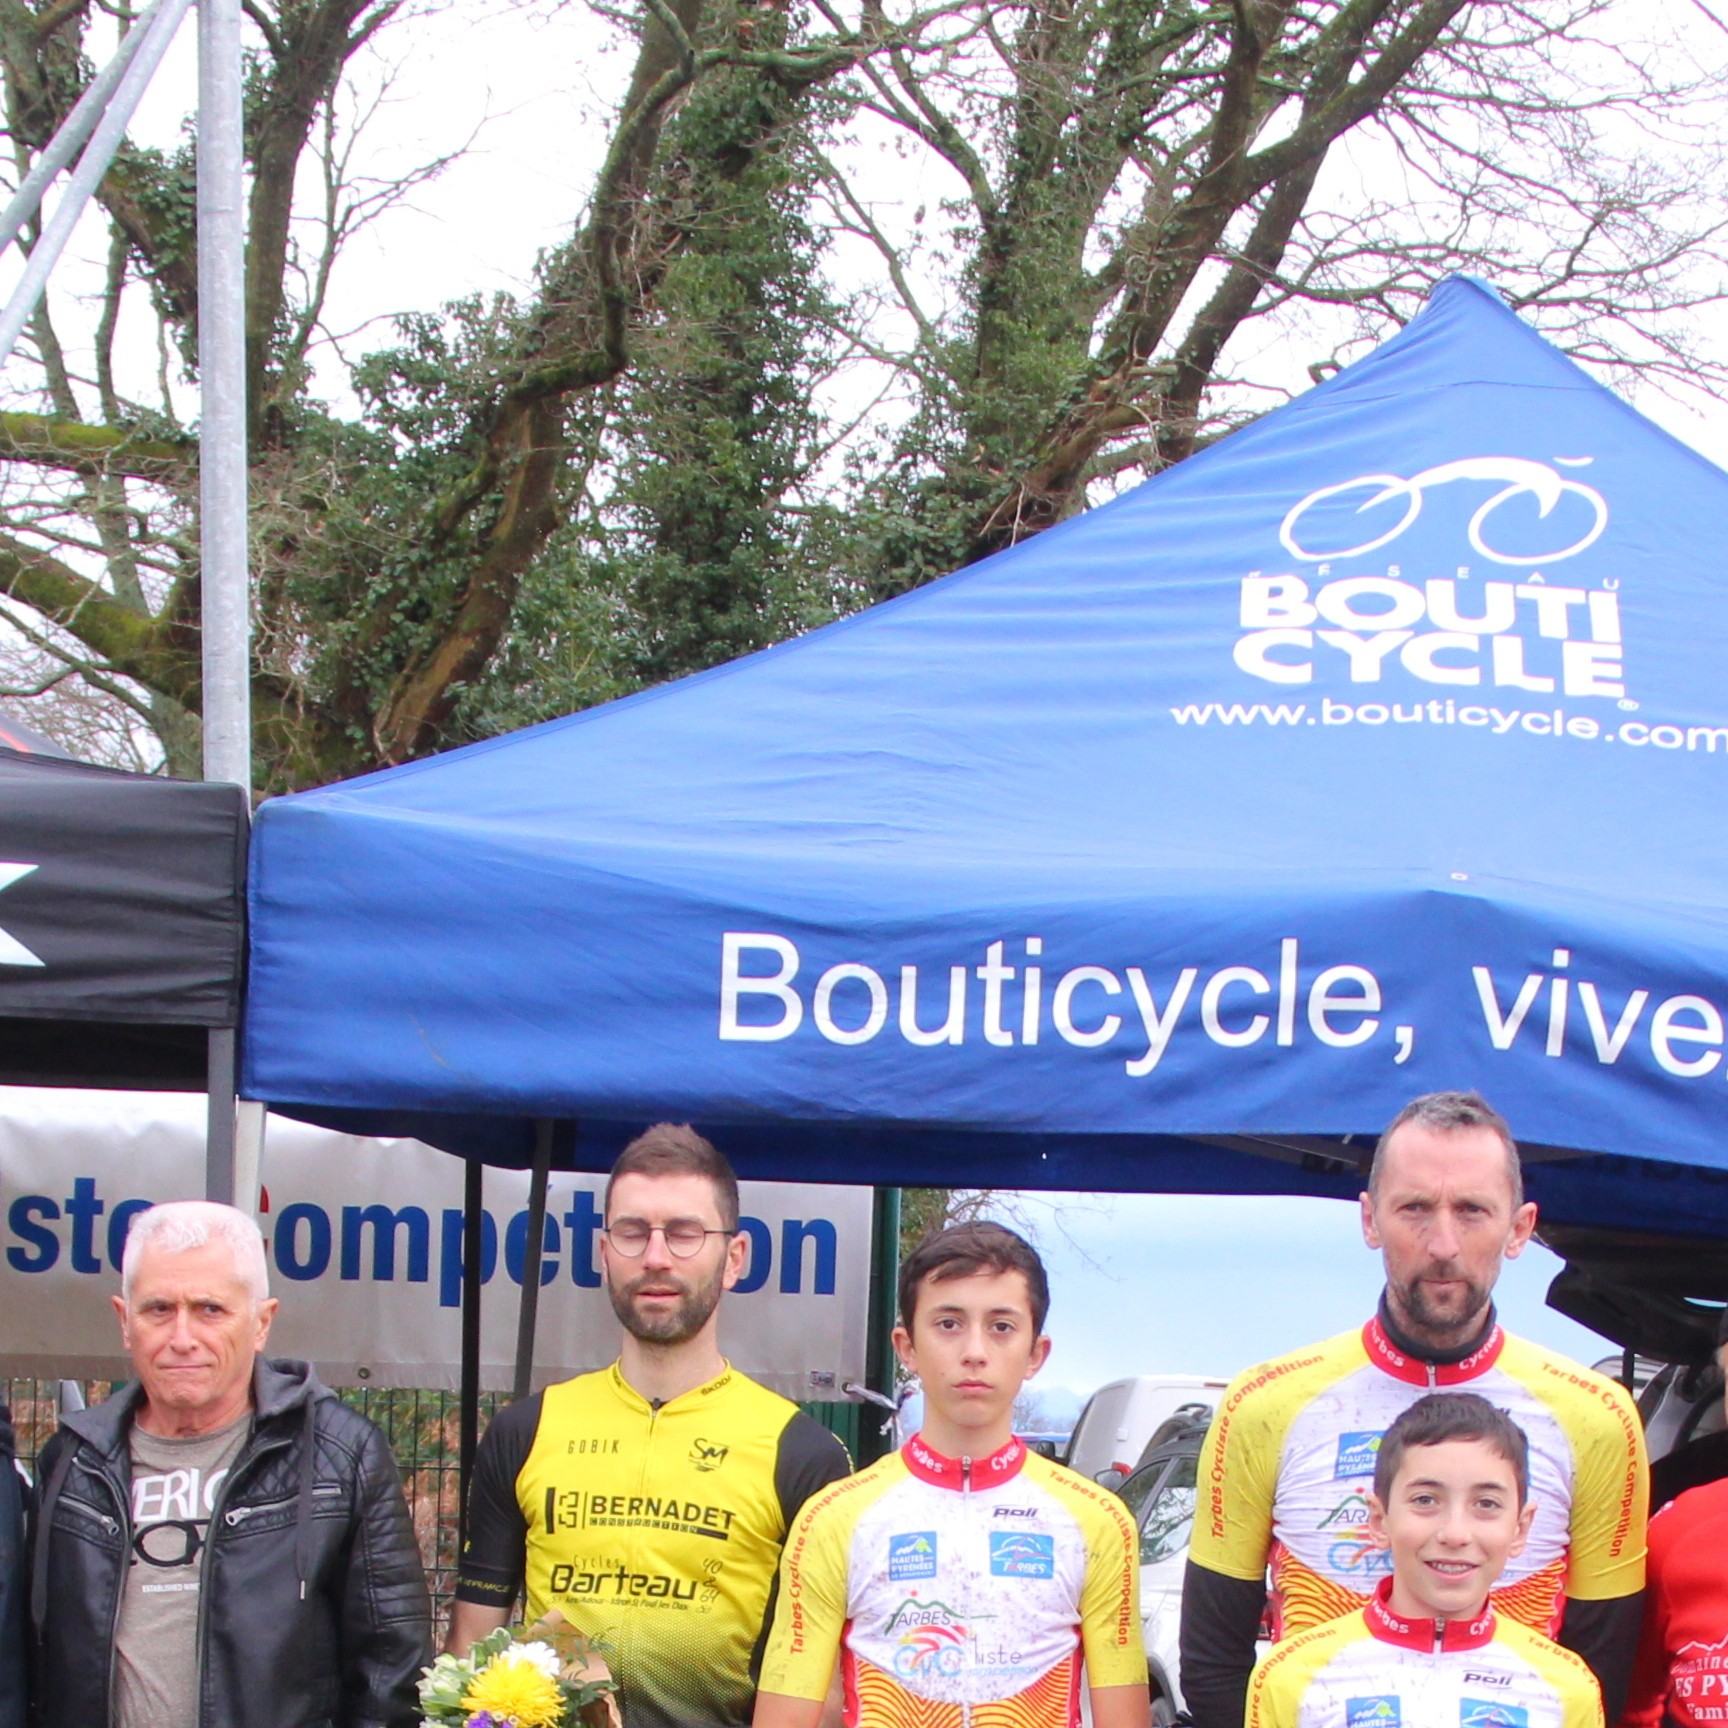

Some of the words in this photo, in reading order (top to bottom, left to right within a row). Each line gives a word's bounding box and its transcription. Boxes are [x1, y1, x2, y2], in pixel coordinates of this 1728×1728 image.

[1240, 575, 1621, 643] BOUTI
[1233, 628, 1626, 697] CYCLE
[719, 932, 1414, 1077] Bouticycle,
[1226, 1355, 1324, 1413] Competition
[1541, 1362, 1599, 1395] Tarbes
[568, 1440, 619, 1454] GOBIK
[1211, 1416, 1230, 1482] Cycliste
[1601, 1391, 1636, 1458] Cycliste
[590, 1495, 736, 1530] BERNADET
[800, 1473, 879, 1534] Competition
[993, 1506, 1039, 1518] poli
[1211, 1484, 1224, 1538] Tarbes
[1609, 1461, 1637, 1557] Competition
[551, 1564, 697, 1600] Barteau
[574, 1555, 619, 1571] Cycles
[789, 1536, 806, 1598] Cycliste
[1050, 1470, 1097, 1500] Tarbes
[1099, 1498, 1131, 1551] Cycliste
[1118, 1554, 1133, 1645] Competition
[790, 1598, 804, 1654] Tarbes
[891, 1611, 952, 1627] TARBES
[1254, 1627, 1336, 1689] Competition
[1464, 1672, 1512, 1686] poli
[1528, 1636, 1579, 1667] Tarbes
